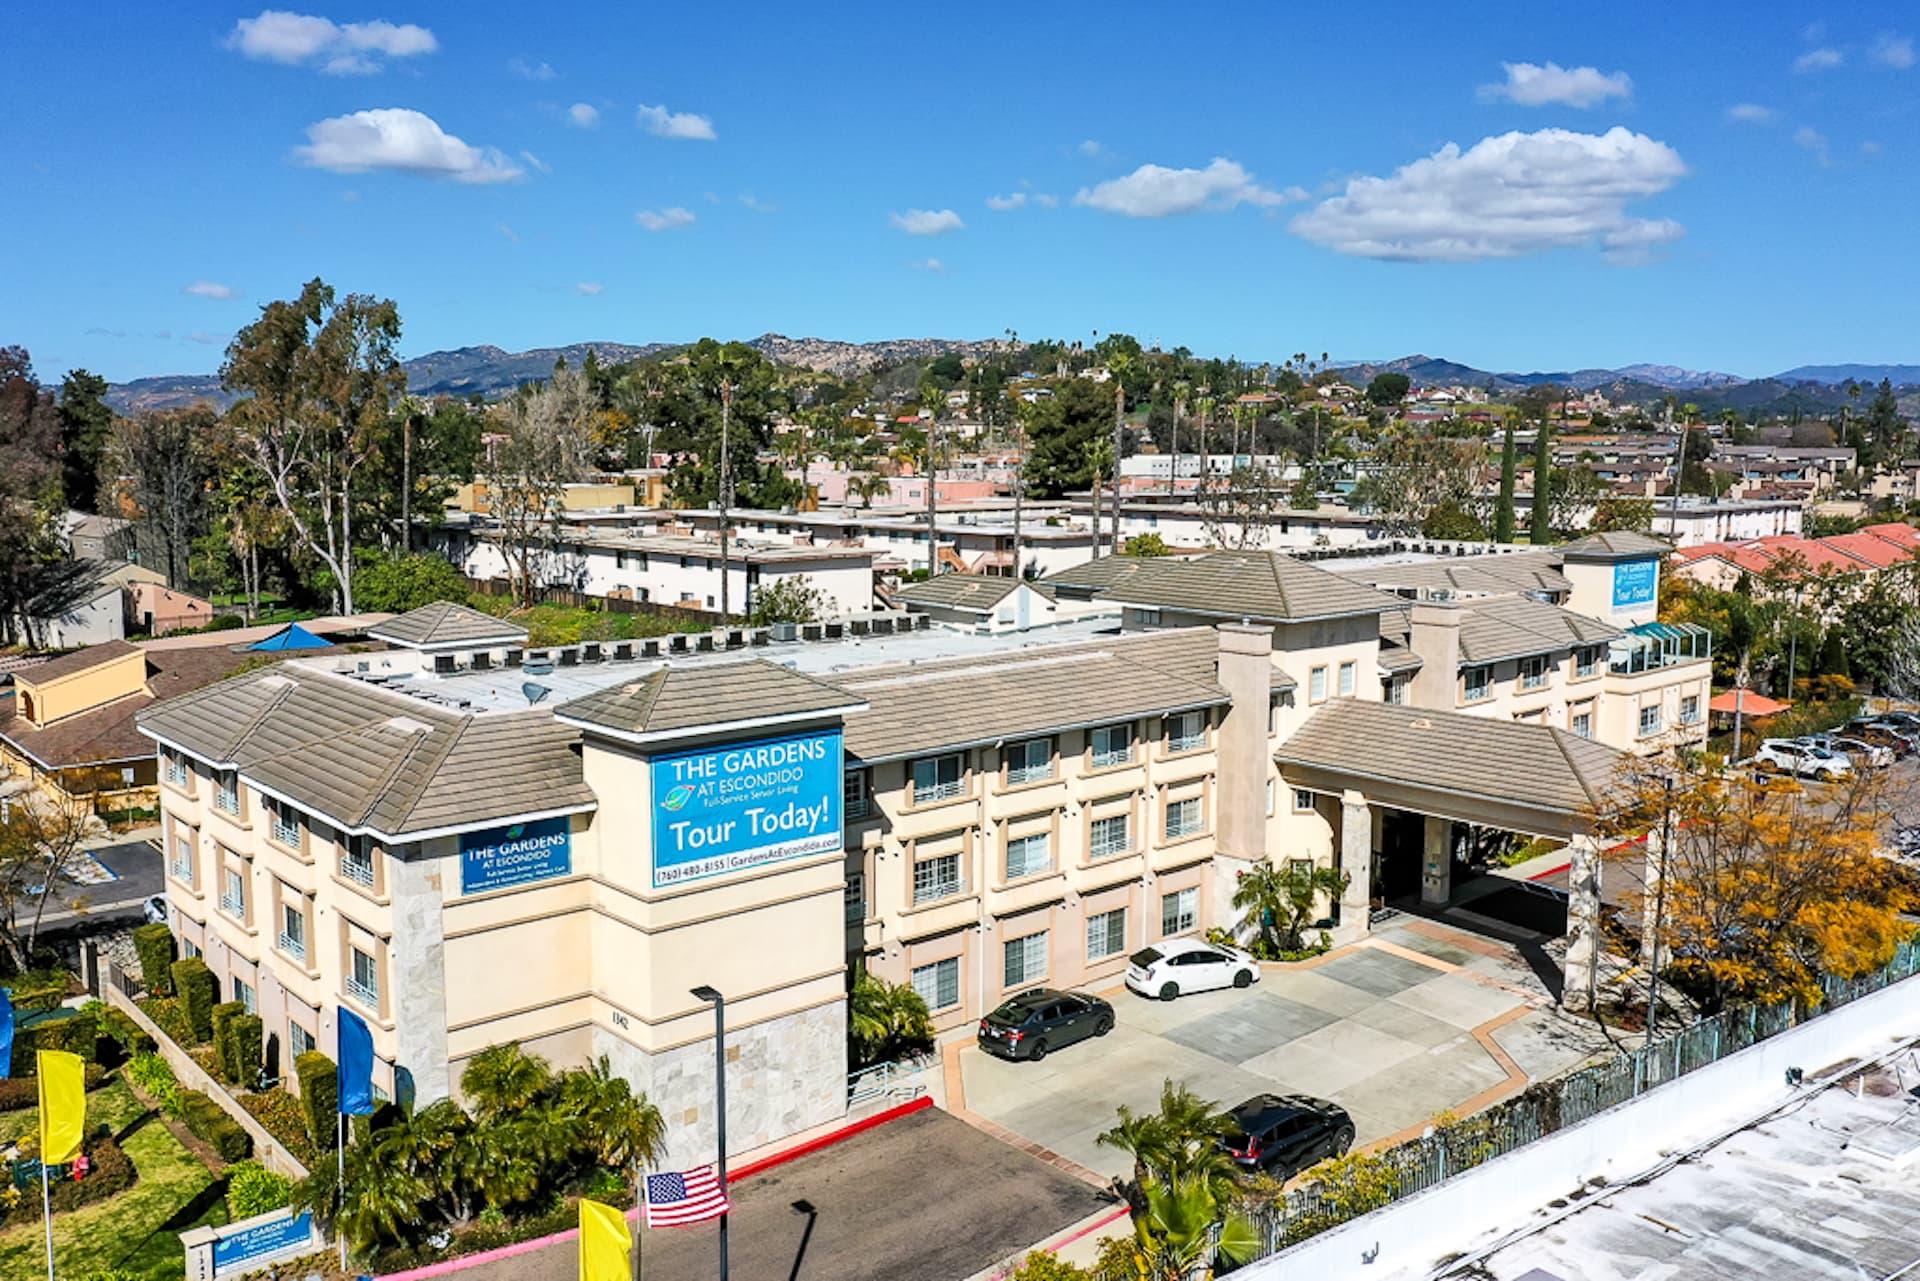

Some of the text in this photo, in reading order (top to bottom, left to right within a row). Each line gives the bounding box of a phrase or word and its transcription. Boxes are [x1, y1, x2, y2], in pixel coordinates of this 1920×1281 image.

[671, 739, 826, 782] THE GARDENS
[697, 766, 804, 798] AT ESCONDIDO
[669, 795, 829, 851] Tour Today!
[466, 831, 566, 862] THE GARDENS
[482, 859, 495, 870] AT
[496, 849, 551, 868] ESCONDIDO
